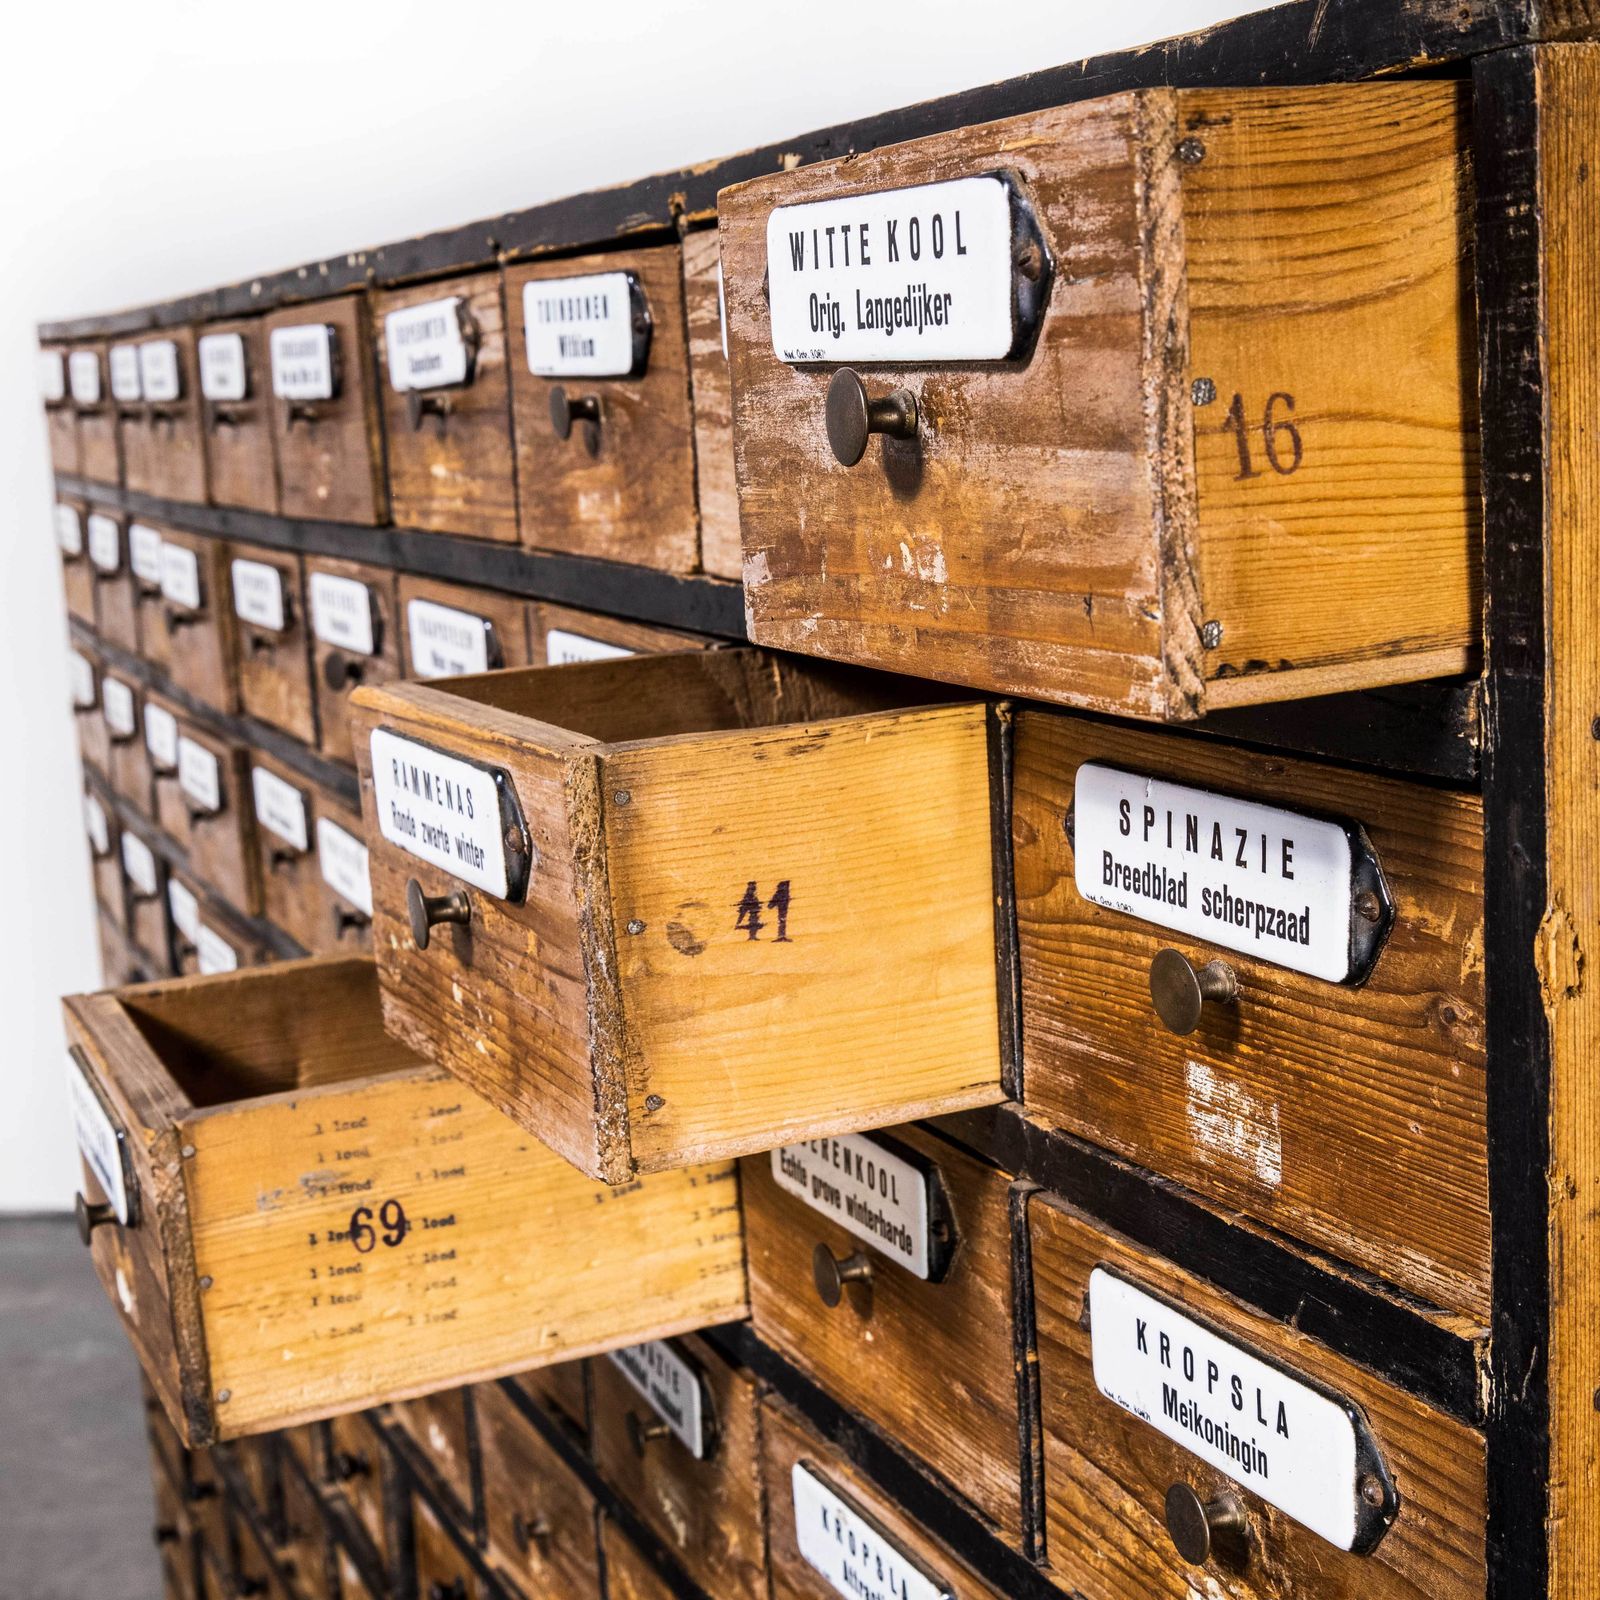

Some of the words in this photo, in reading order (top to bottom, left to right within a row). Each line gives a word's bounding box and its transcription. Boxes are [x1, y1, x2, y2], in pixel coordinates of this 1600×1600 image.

[789, 223, 871, 272] WITTE
[886, 210, 967, 263] KOOL
[809, 292, 846, 339] Orig.
[856, 283, 952, 337] Langedijker
[1222, 391, 1303, 482] 16
[392, 757, 475, 820] RAMMENAS
[421, 821, 451, 855] zwarte
[454, 832, 485, 872] winter
[1118, 798, 1295, 881] SPINAZIE
[733, 879, 794, 943] 41
[1102, 849, 1189, 909] Breedblad
[1201, 883, 1311, 947] scherpzaad
[349, 1199, 407, 1254] 69
[845, 1193, 913, 1257] winterharde
[1135, 1317, 1290, 1440] KROPSLA
[1162, 1381, 1269, 1479] Meikoningin
